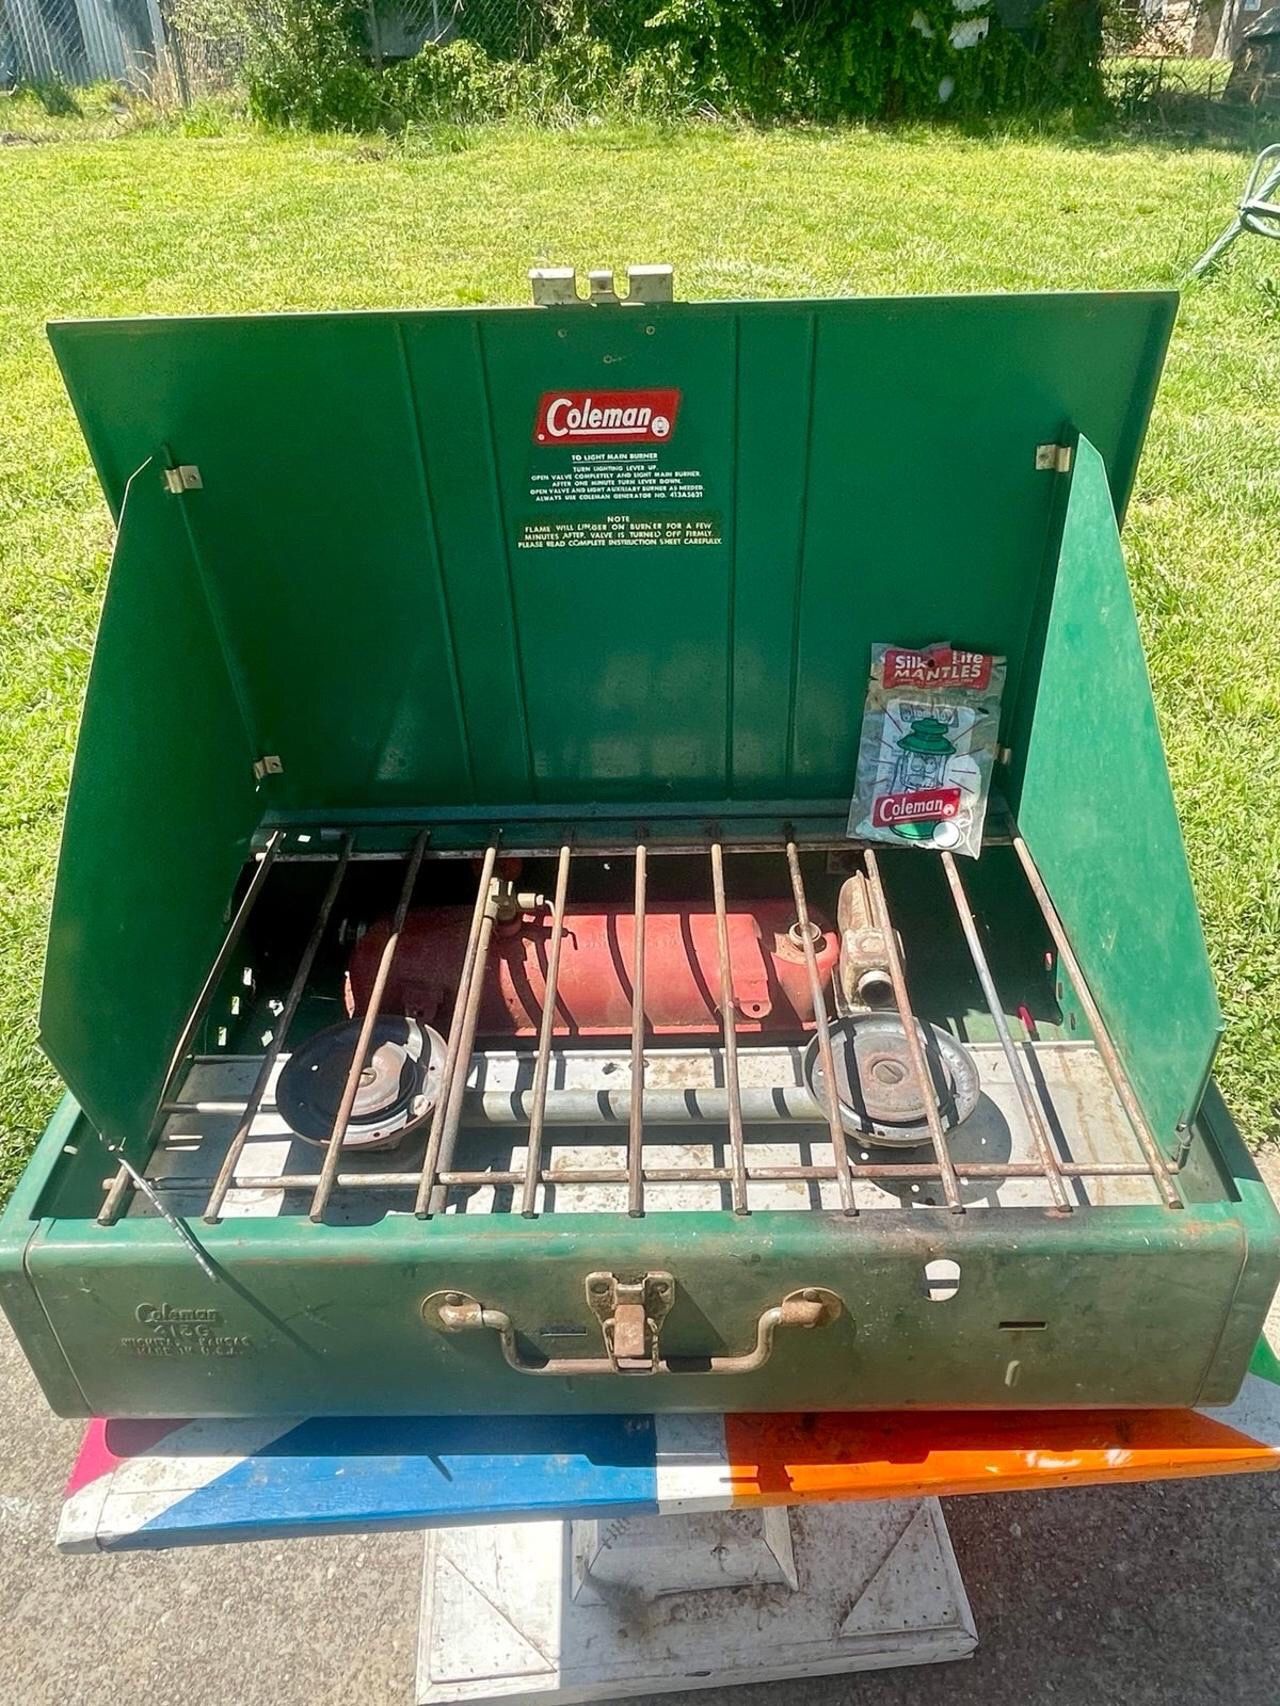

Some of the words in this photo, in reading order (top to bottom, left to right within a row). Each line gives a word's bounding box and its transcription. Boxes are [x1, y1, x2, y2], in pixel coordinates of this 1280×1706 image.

[547, 398, 651, 437] Coleman
[894, 665, 981, 680] MANTLES
[880, 796, 943, 822] Coleman
[135, 1302, 217, 1323] Coleman
